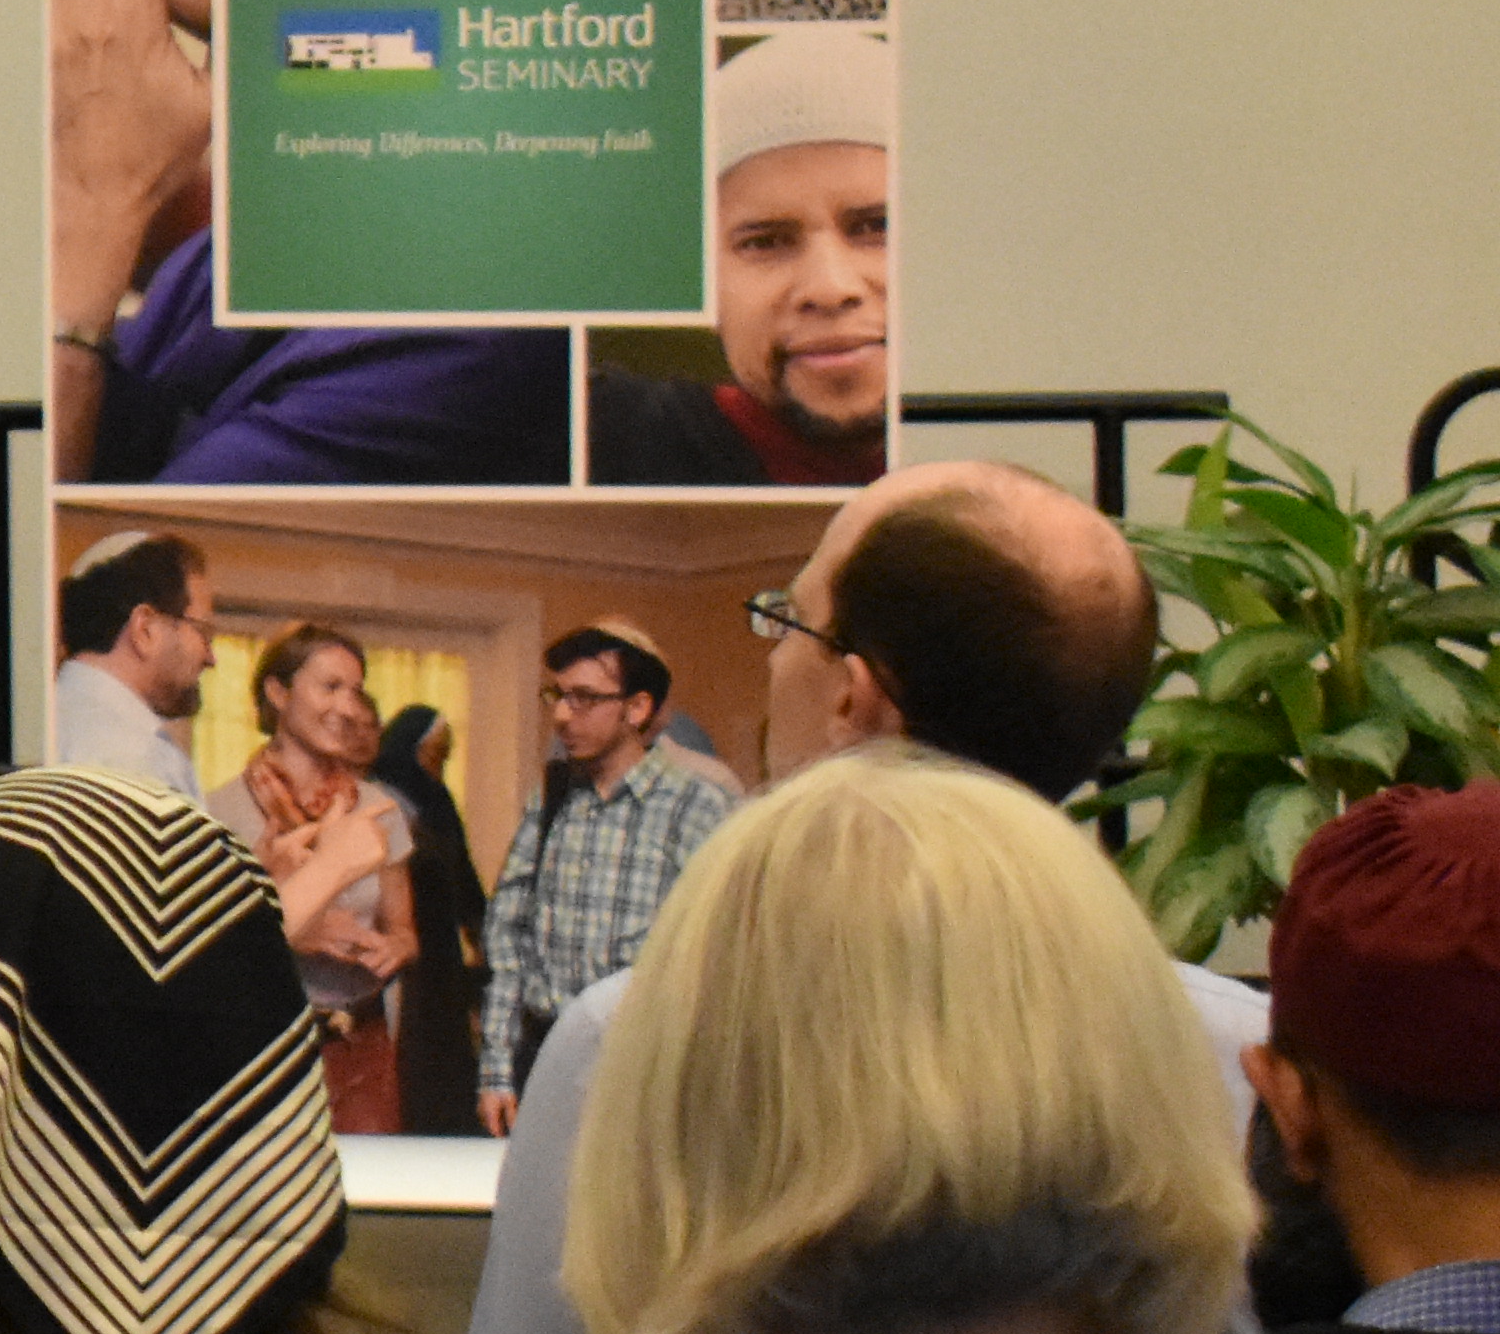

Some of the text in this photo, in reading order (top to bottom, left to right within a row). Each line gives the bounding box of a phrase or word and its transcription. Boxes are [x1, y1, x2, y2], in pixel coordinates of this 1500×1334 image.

[457, 3, 656, 48] Hartford
[457, 60, 653, 92] SEMINARY
[276, 131, 373, 160] Exploring
[494, 130, 598, 159] Deepening
[603, 128, 653, 152] Faith
